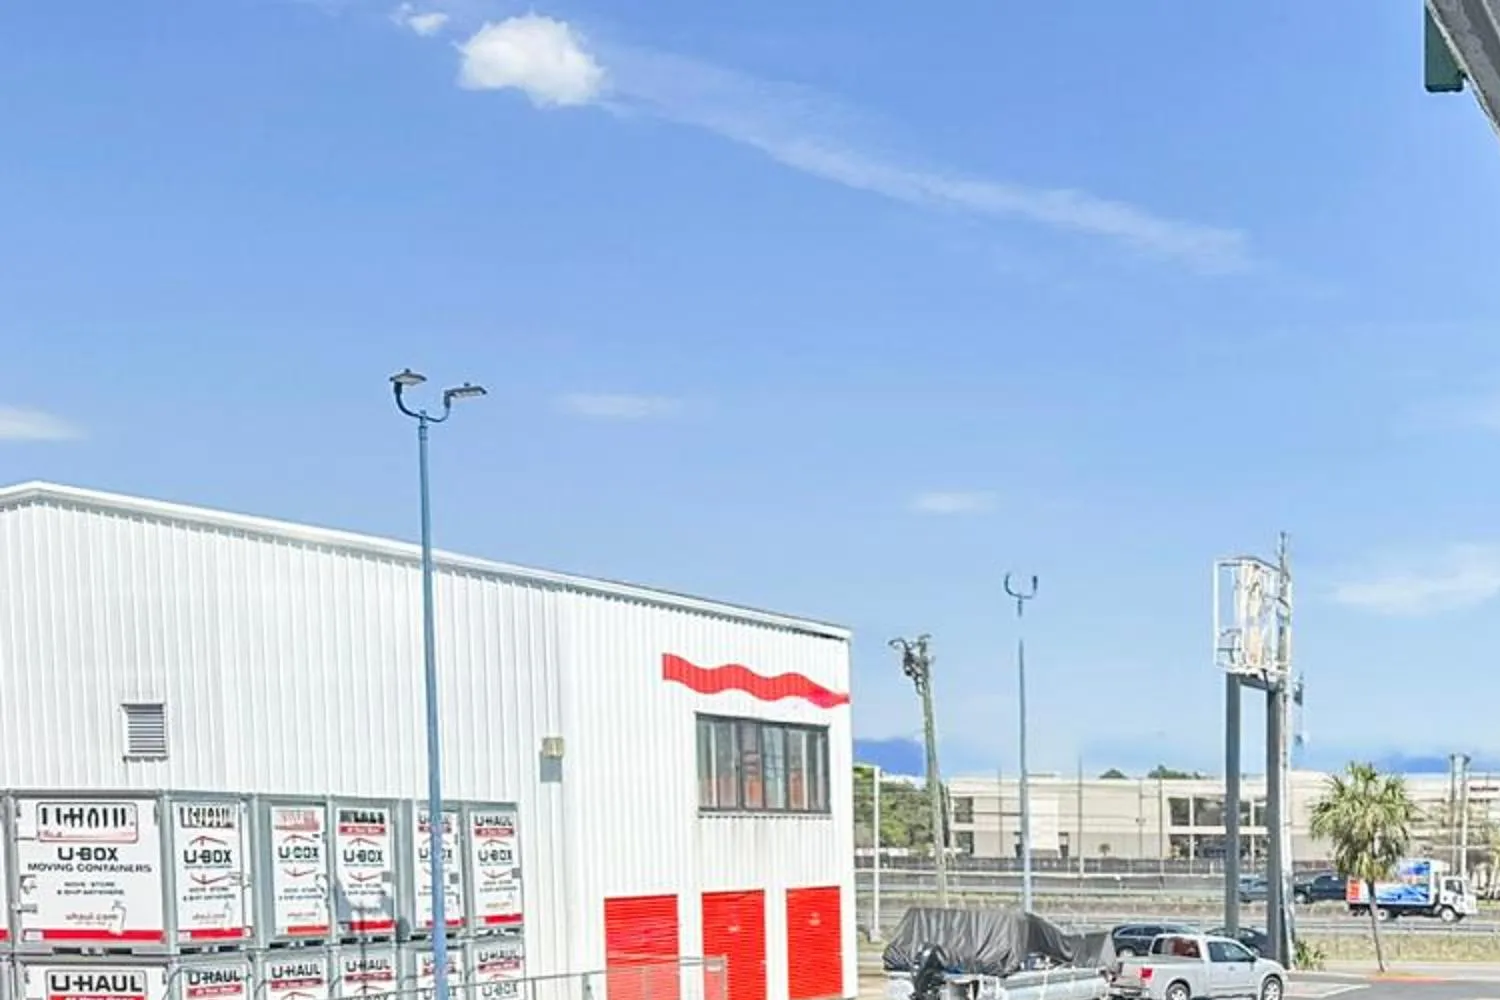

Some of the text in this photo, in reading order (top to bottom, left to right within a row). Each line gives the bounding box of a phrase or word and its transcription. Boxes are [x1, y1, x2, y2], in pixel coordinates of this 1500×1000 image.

[57, 847, 119, 862] U-BOX
[183, 849, 233, 864] U-BOX
[27, 863, 152, 873] MOVING CONTAINERS
[271, 963, 321, 978] U-HAUL
[346, 959, 391, 972] U-HAUL
[51, 975, 143, 992] U-HAUL
[188, 970, 241, 985] U-HAUL
